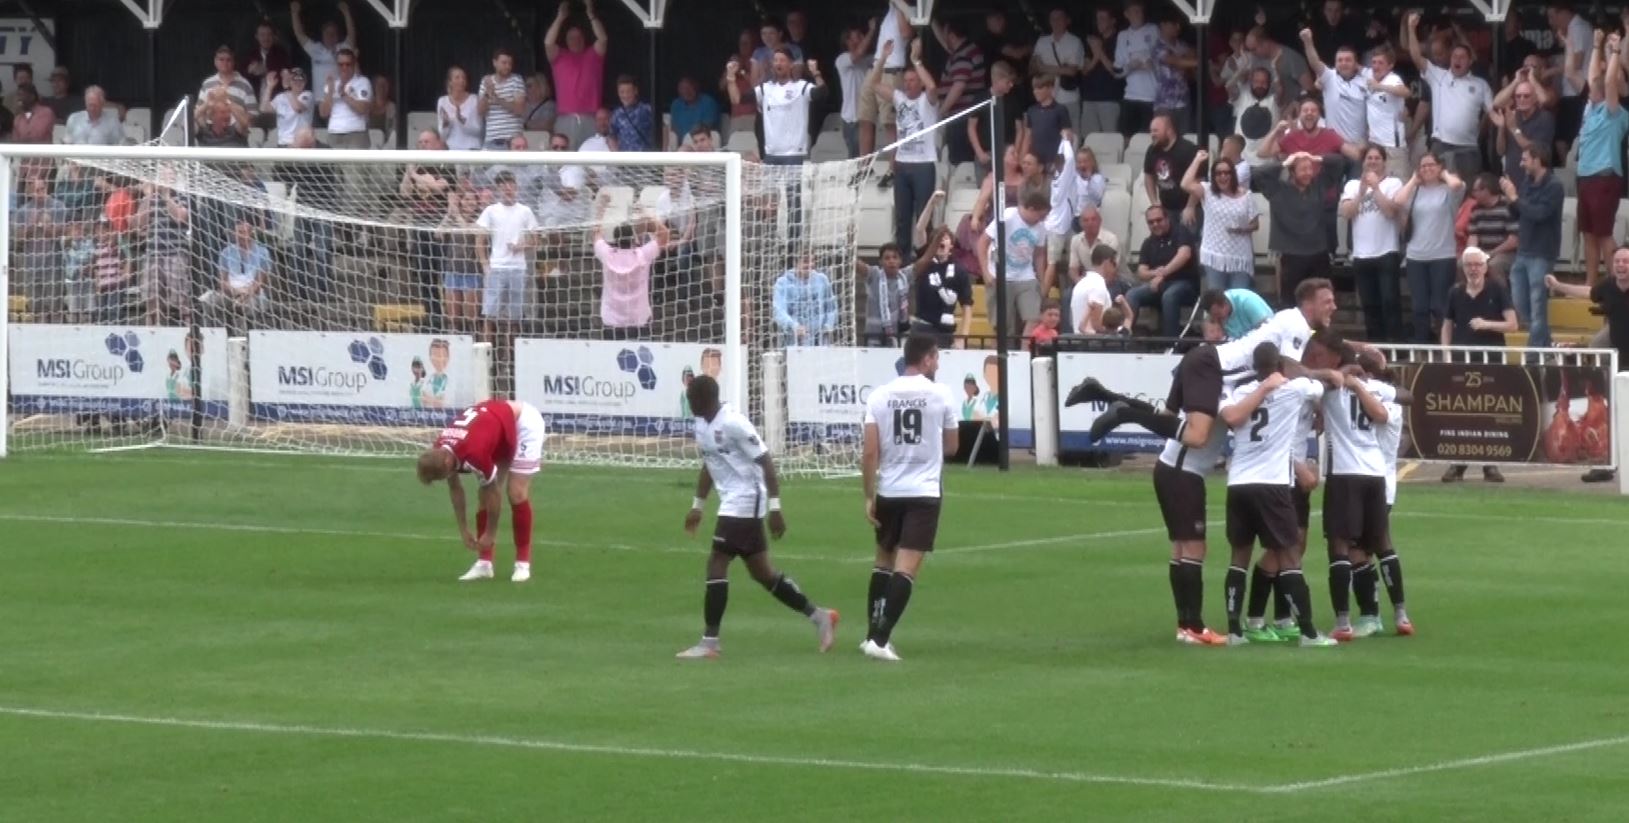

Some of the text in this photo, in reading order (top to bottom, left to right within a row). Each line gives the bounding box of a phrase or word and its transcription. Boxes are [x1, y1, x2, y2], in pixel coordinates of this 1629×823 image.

[1465, 371, 1481, 387] 25
[887, 399, 927, 408] FRANCIS
[1425, 393, 1523, 412] SHAMPAN
[893, 409, 922, 445] 19
[1250, 407, 1269, 442] 2
[1457, 430, 1482, 438] INDIAN
[1437, 443, 1512, 457] 020 8304 9569
